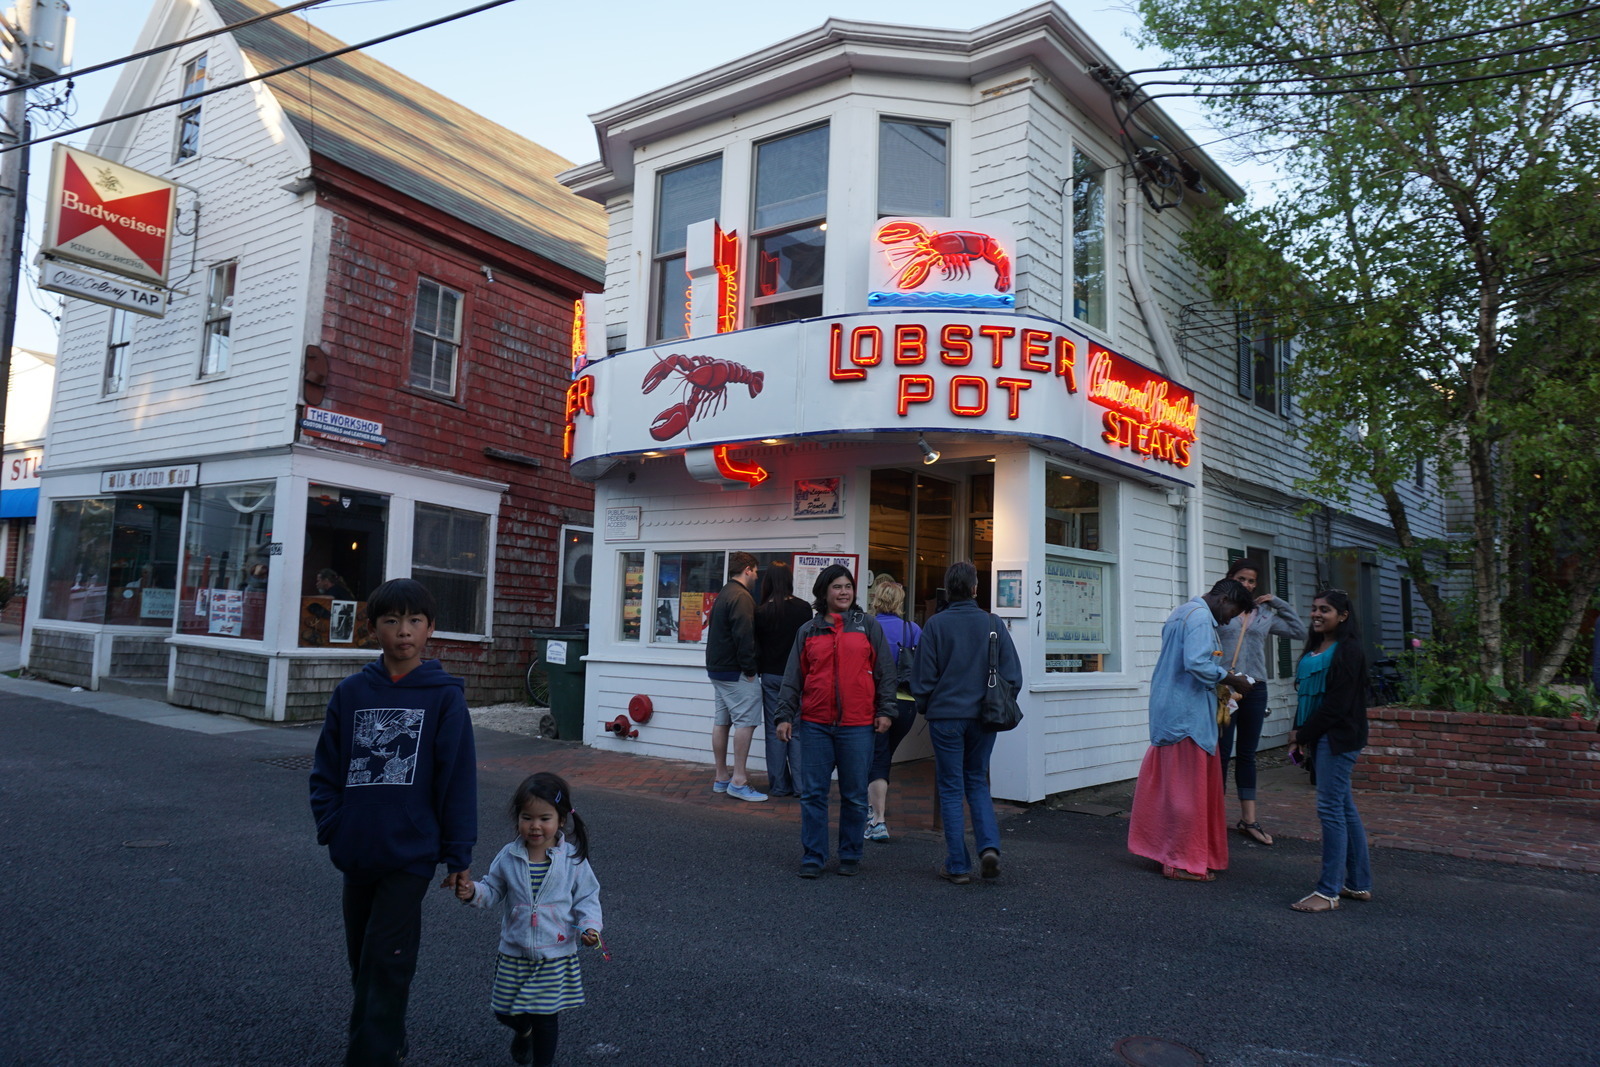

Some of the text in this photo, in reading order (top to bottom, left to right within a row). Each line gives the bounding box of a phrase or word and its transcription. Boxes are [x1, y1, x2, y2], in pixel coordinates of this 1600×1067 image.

[62, 190, 166, 239] Budweiser
[70, 242, 146, 270] KING OF BEERS
[53, 270, 160, 306] Old Colony TAP
[829, 322, 1077, 394] LOBSTER
[897, 373, 1032, 420] POT
[302, 419, 322, 430] CUSTOM
[323, 424, 343, 434] SANDALS
[351, 431, 370, 440] LEATHER
[310, 409, 380, 433] THE WORKSHOP
[1101, 409, 1192, 469] STEAKS
[108, 473, 126, 488] Old
[168, 467, 190, 486] Tap
[798, 557, 830, 567] WATERFRONT
